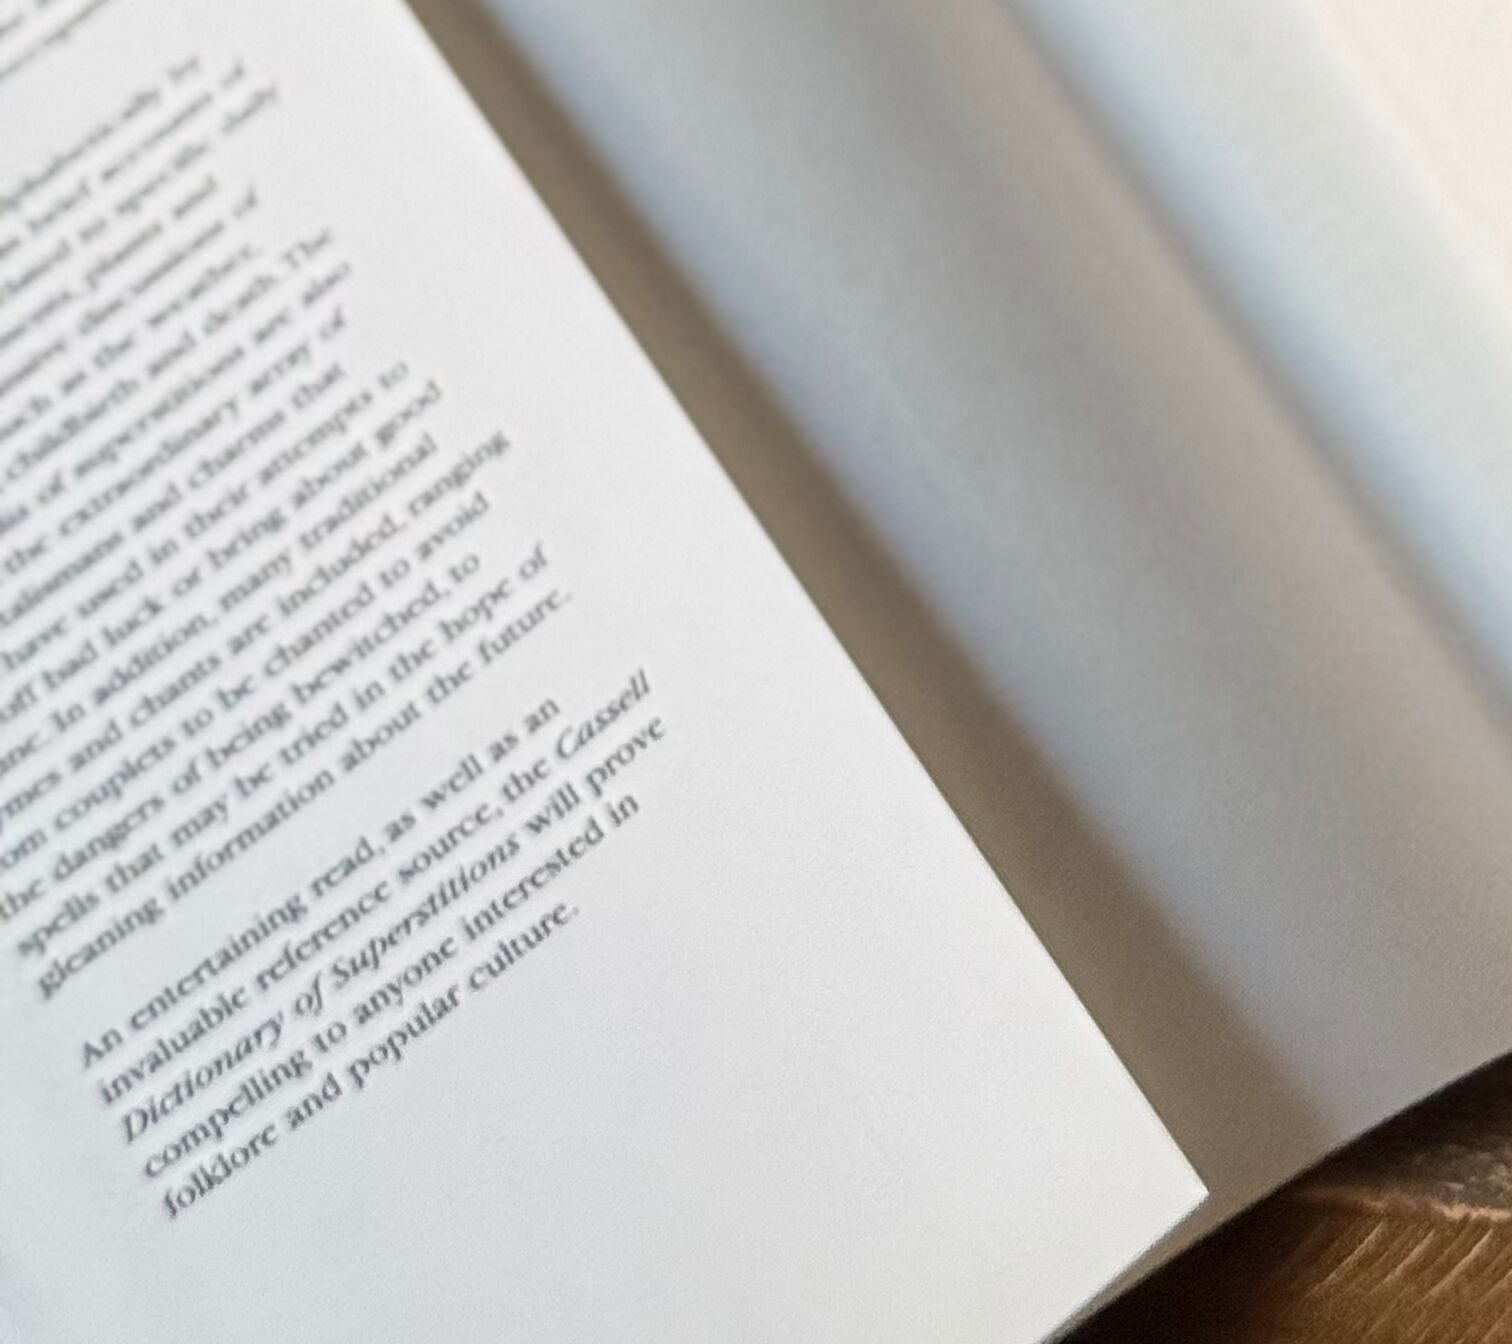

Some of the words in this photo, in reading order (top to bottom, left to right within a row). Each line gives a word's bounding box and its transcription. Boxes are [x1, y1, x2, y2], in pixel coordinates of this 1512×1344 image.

[0, 615, 67, 673] have
[75, 558, 144, 619] used
[147, 537, 180, 567] in
[181, 482, 249, 541] their
[256, 389, 374, 488] attempts
[375, 360, 409, 392] to
[57, 396, 239, 538] extraordinary
[246, 341, 311, 398] array
[317, 304, 347, 342] of
[71, 345, 246, 481] superstitions
[130, 481, 183, 534] and
[186, 408, 287, 490] charms
[289, 362, 345, 411] that
[145, 329, 197, 381] and
[39, 638, 99, 692] bad
[100, 596, 165, 649] luck
[170, 566, 203, 599] or
[204, 506, 288, 571] bring
[289, 441, 368, 510] about
[372, 378, 442, 450] good
[48, 702, 86, 734] In
[91, 613, 217, 707] addition,
[217, 549, 292, 613] many
[297, 431, 438, 552] traditional
[52, 735, 177, 833] couplets
[179, 707, 214, 739] to
[214, 674, 254, 711] be
[262, 580, 376, 678] chanted
[377, 557, 411, 590] to
[415, 489, 490, 562] avoid
[66, 718, 124, 774] and
[128, 653, 222, 729] chants
[226, 613, 270, 656] are
[275, 512, 407, 619] included,
[406, 431, 510, 518] ranging
[15, 891, 100, 958] spells
[103, 842, 165, 895] that
[168, 792, 228, 849] may
[232, 762, 272, 800] be
[277, 700, 350, 766] tried
[351, 680, 386, 713] in
[387, 639, 435, 684] the
[437, 578, 512, 644] hope
[517, 542, 548, 581] of
[36, 897, 165, 1001] gleaning
[165, 769, 335, 902] information
[339, 701, 422, 773] about
[424, 660, 471, 706] the
[475, 589, 572, 665] future.
[50, 794, 165, 883] dangers
[169, 757, 202, 796] of
[203, 701, 292, 771] being
[289, 579, 451, 706] bewitched,
[446, 553, 480, 585] to
[82, 1028, 124, 1069] An
[128, 893, 308, 1032] entertaining
[308, 835, 386, 899] read,
[384, 812, 416, 843] as
[419, 753, 484, 811] well
[487, 732, 519, 763] as
[522, 698, 560, 735] an
[99, 986, 246, 1106] invaluable
[254, 880, 390, 993] reference
[396, 803, 504, 885] source,
[500, 757, 549, 803] the
[554, 668, 650, 761] Cassell
[121, 1010, 283, 1145] Dictionary
[292, 970, 323, 1017] of
[329, 833, 520, 990] Superstitions
[523, 781, 581, 834] will
[584, 717, 664, 798] prove
[143, 1049, 313, 1179] compelling
[310, 1021, 347, 1054] to
[352, 936, 456, 1026] anyone
[460, 814, 605, 941] interested
[605, 794, 639, 828] in
[162, 1123, 277, 1219] folklore
[284, 1071, 343, 1131] and
[345, 983, 459, 1090] popular
[467, 903, 578, 992] culture.
